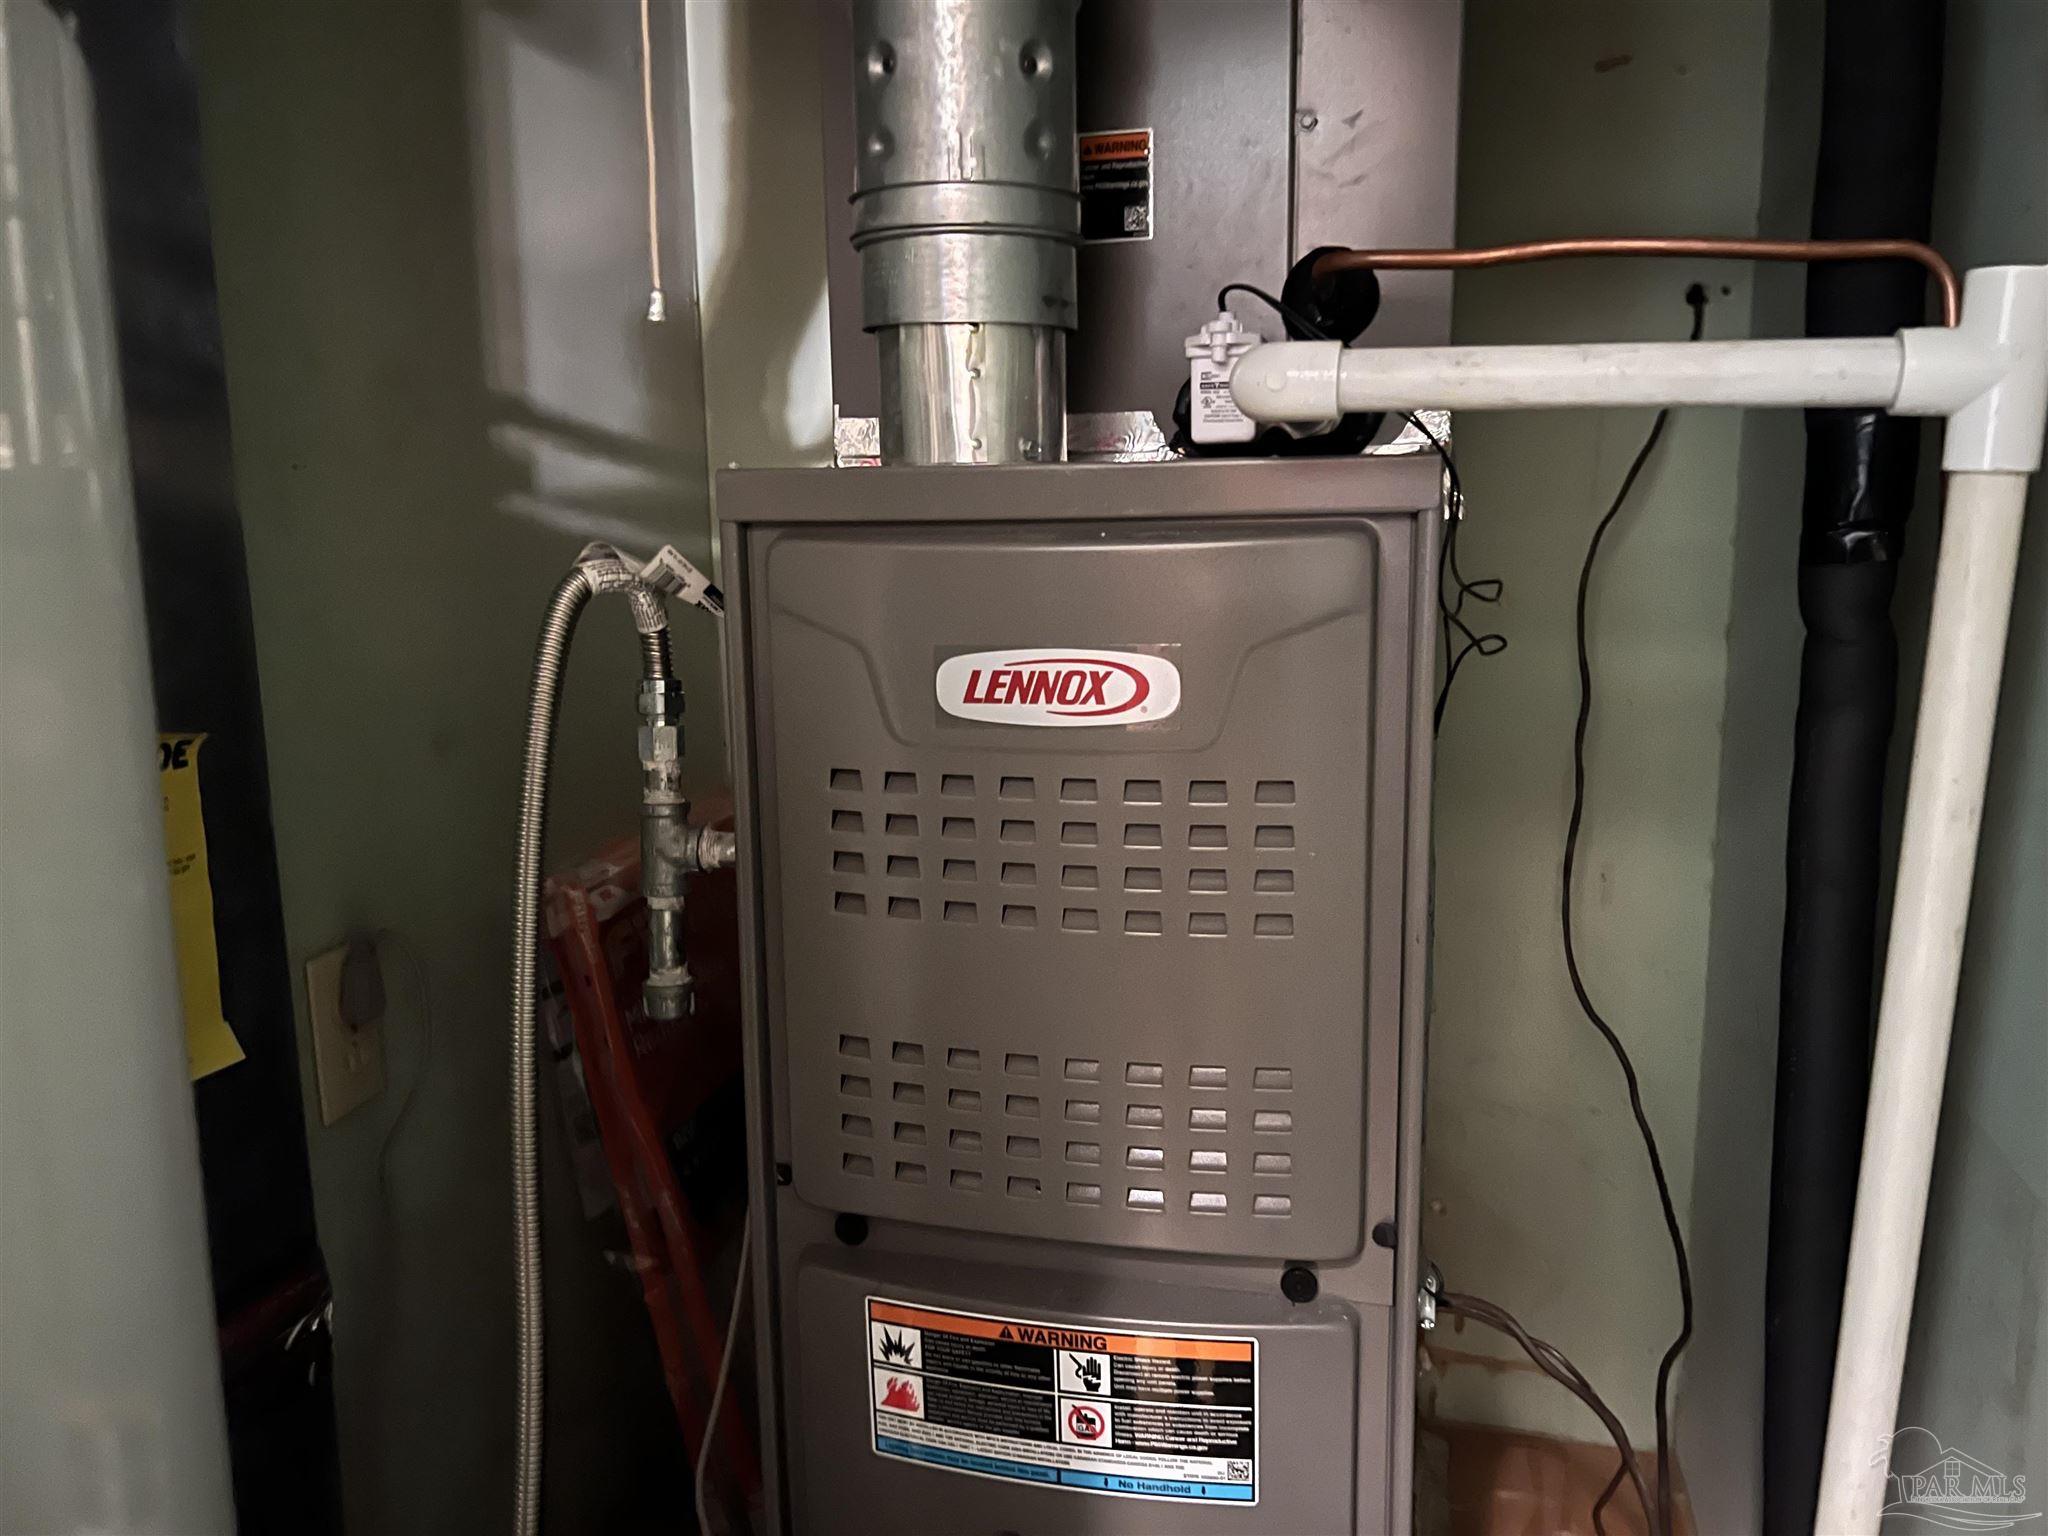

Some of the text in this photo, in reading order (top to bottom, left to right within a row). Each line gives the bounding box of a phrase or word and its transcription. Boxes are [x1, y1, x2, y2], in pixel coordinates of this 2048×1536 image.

[962, 669, 1114, 706] LENNOX
[1017, 1327, 1107, 1351] WARNING
[1118, 1479, 1191, 1494] No Handhold
